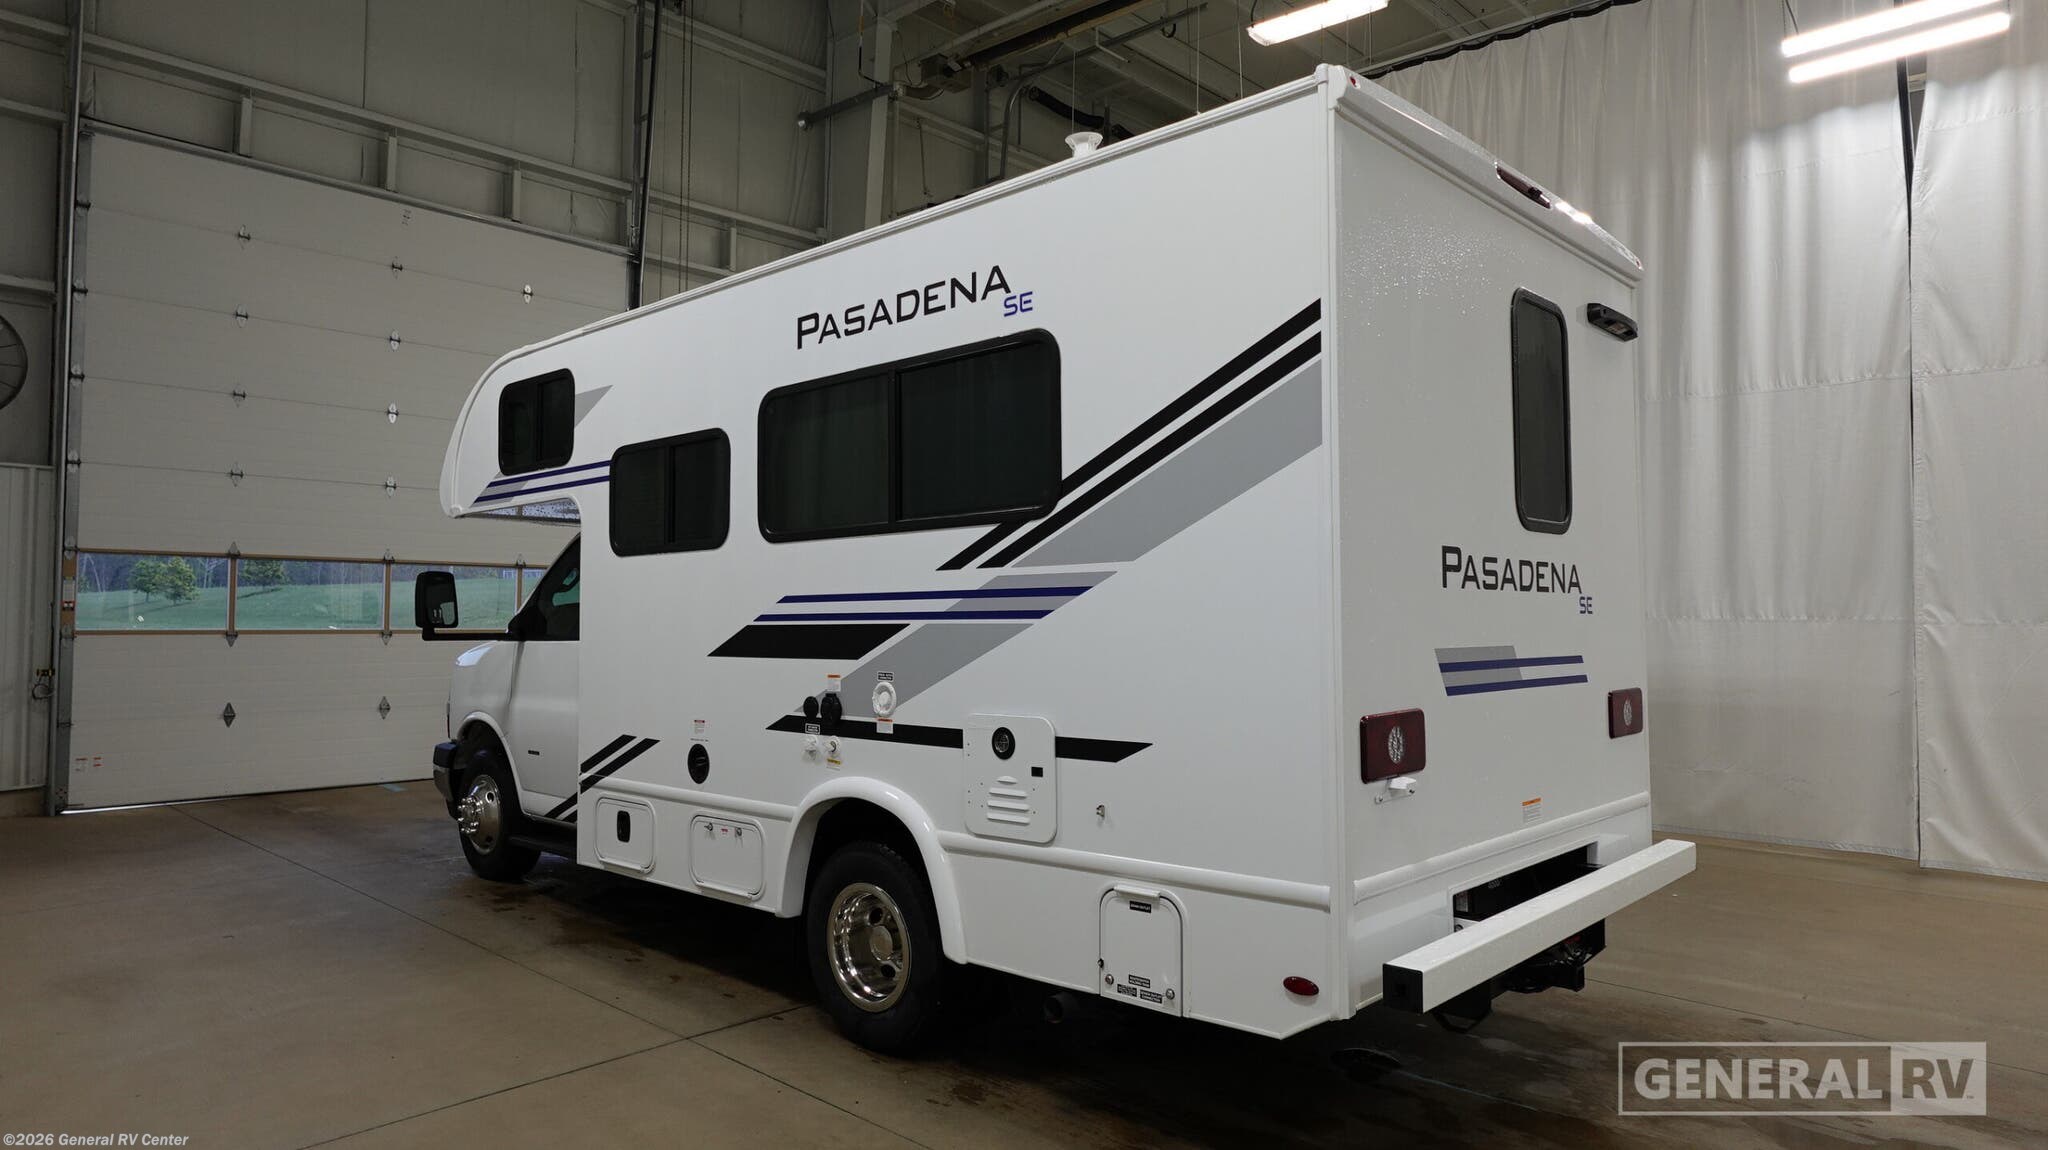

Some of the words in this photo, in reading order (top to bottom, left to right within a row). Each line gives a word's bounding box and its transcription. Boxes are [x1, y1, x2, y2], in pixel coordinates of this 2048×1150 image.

[797, 265, 1012, 350] PASADENA
[1003, 291, 1033, 317] SE
[1441, 545, 1582, 594] PASADENA
[1579, 596, 1593, 615] SE
